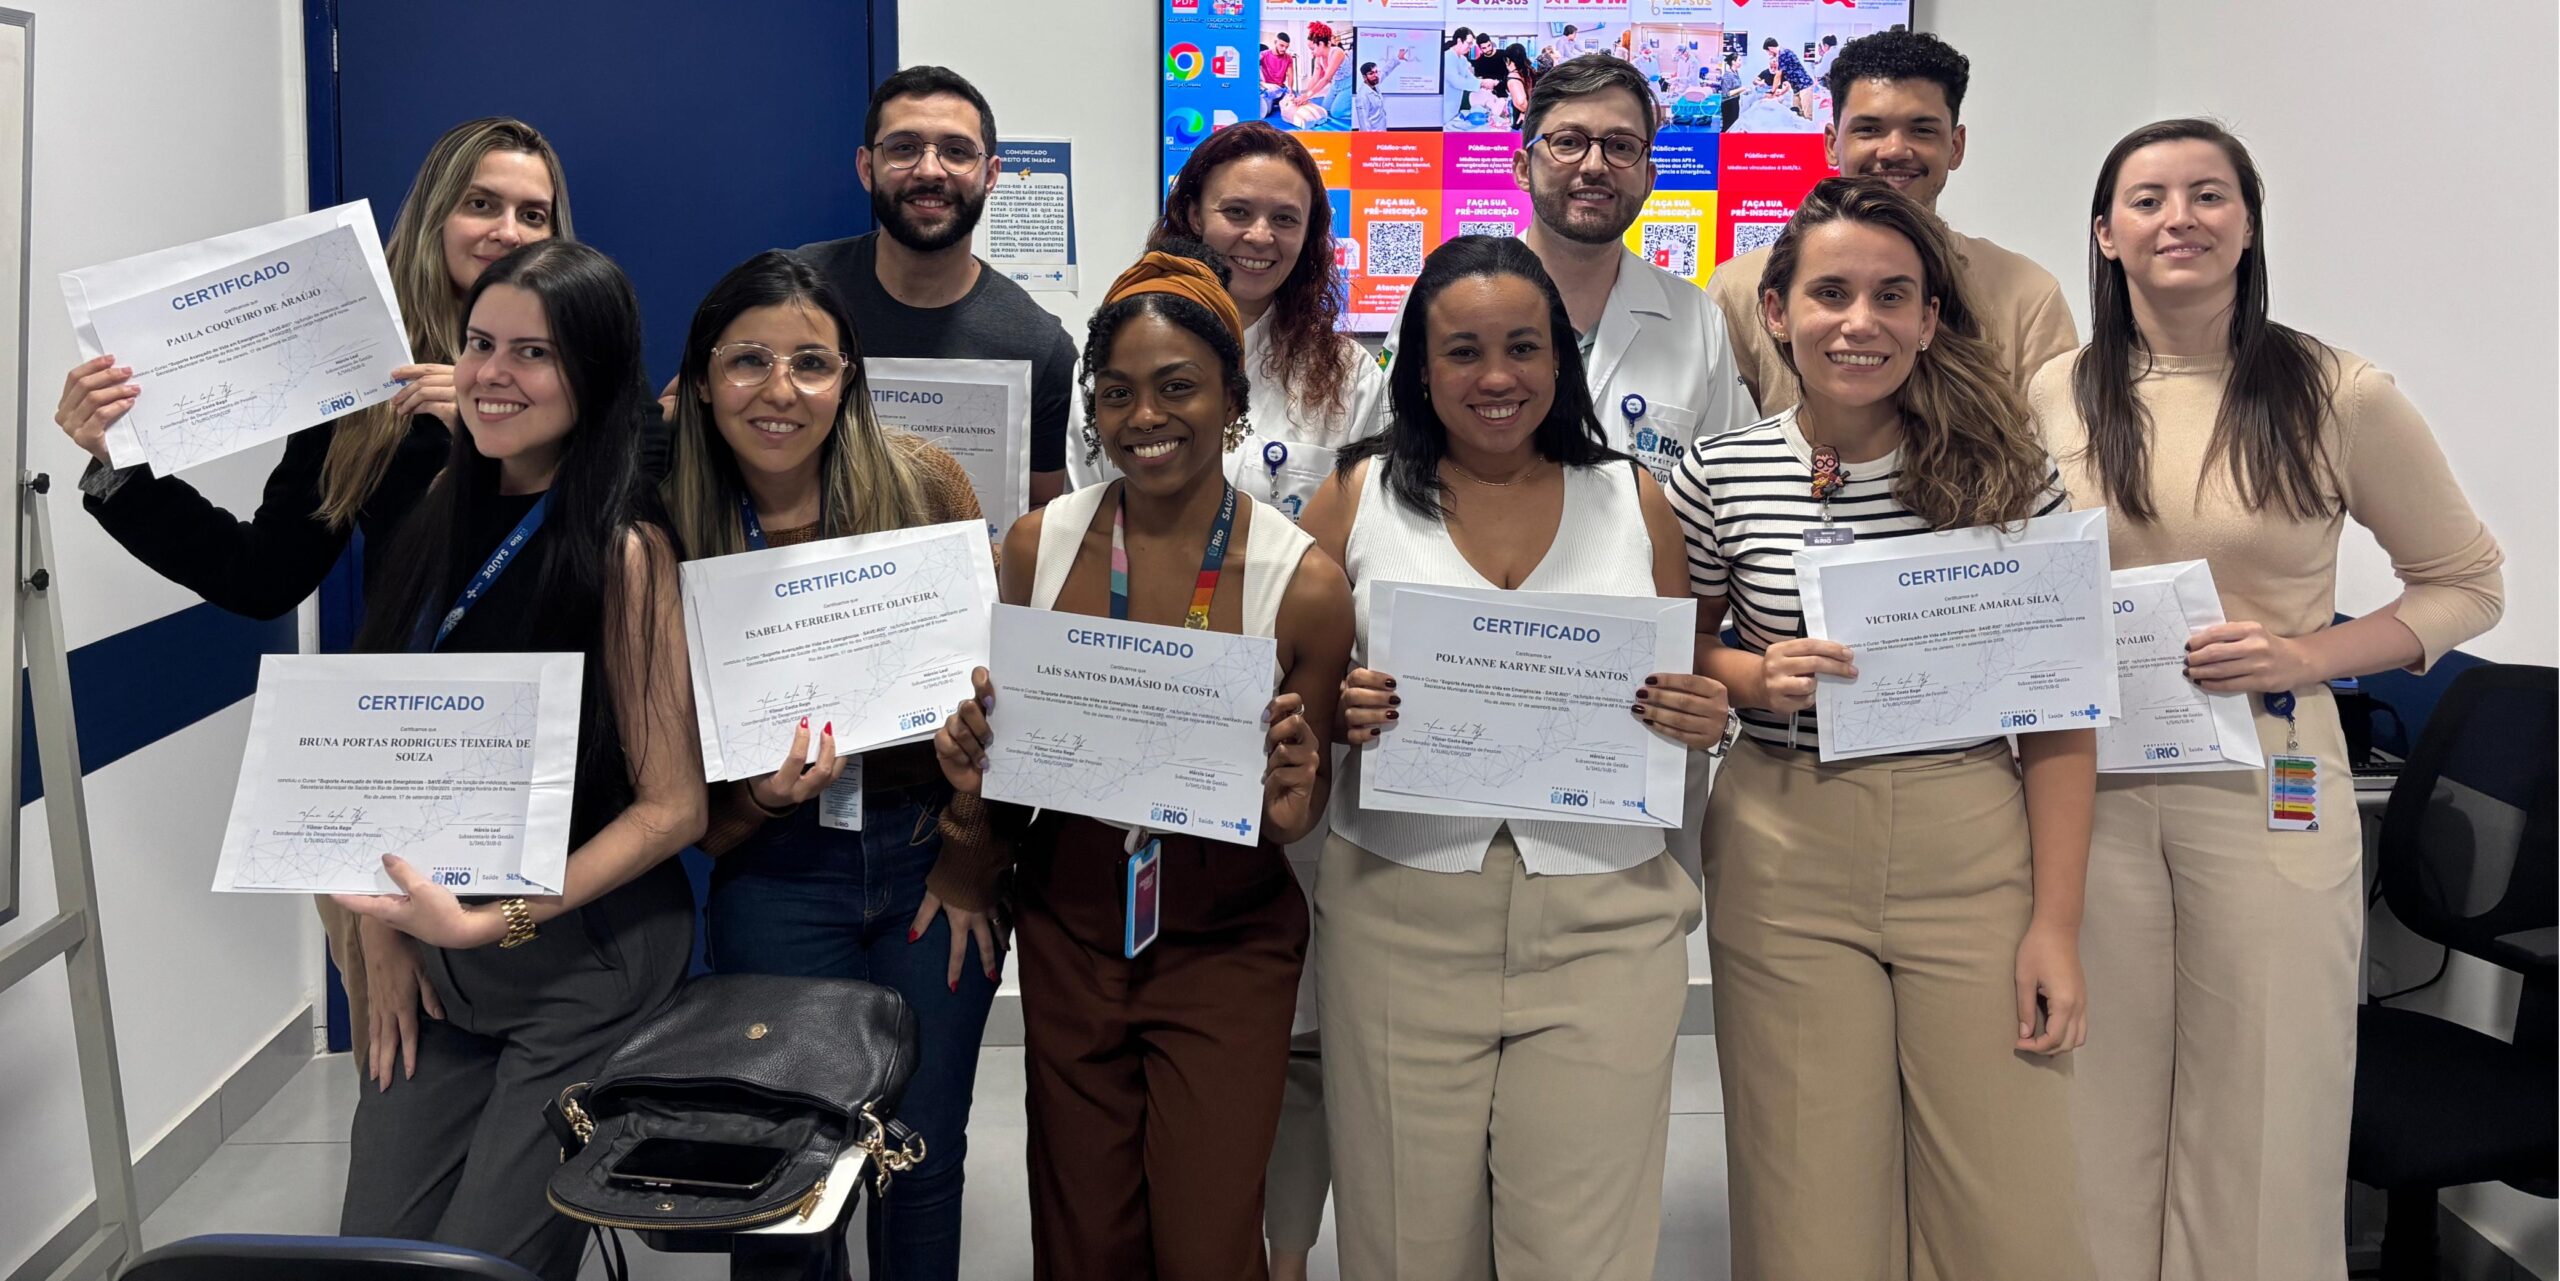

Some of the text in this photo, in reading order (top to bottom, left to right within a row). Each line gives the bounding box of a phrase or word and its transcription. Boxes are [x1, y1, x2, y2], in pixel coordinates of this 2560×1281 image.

[1375, 198, 1415, 208] FAÇA SUA
[1467, 198, 1507, 208] FAÇA SUA
[1650, 199, 1691, 209] FAÇA SUA
[1742, 199, 1783, 209] FAÇA SUA
[1363, 207, 1428, 217] PRÉ-INSCRIÇÃO
[1455, 207, 1519, 218] PRÉ-INSCRIÇÃO
[171, 259, 290, 311] CERTIFICADO
[166, 286, 321, 346] PAULA COQUEIRO DE ARAÚJO
[330, 395, 355, 412] RIO
[871, 389, 943, 405] TIFICADO
[910, 424, 996, 435] GOMES PARANHOS
[1658, 436, 1685, 460] Rio
[510, 534, 523, 546] Rio
[1211, 529, 1225, 547] Rio
[482, 548, 509, 580] SAÚDE
[773, 559, 897, 599] CERTIFICADO
[1897, 559, 2020, 587] CERTIFICADO
[744, 590, 939, 640] ISABELA FERREIRA LEITE OLIVEIRA
[1865, 592, 2060, 625] VICTORIA CAROLINE AMARAL SILVA
[1472, 615, 1601, 643] CERTIFICADO
[1066, 627, 1194, 659] CERTIFICADO
[1435, 652, 1629, 682] POLYANNE KARYNE SILVA SANTOS
[1036, 663, 1220, 698] LAÍS SANTOS DAMÁSIO DA COSTA
[357, 694, 485, 711] CERTIFICADO
[911, 711, 936, 728] RIO
[2012, 713, 2037, 727] RIO
[298, 737, 531, 748] BRUNA PORTAS RODRIGUES TEIXEIRA DE
[394, 751, 433, 762] SOUZA
[2155, 746, 2179, 759] RIO
[1562, 792, 1588, 807] RIO
[1162, 809, 1188, 825] RIO
[1221, 820, 1234, 829] SUS
[444, 871, 471, 886] RIO
[505, 873, 521, 881] SUS
